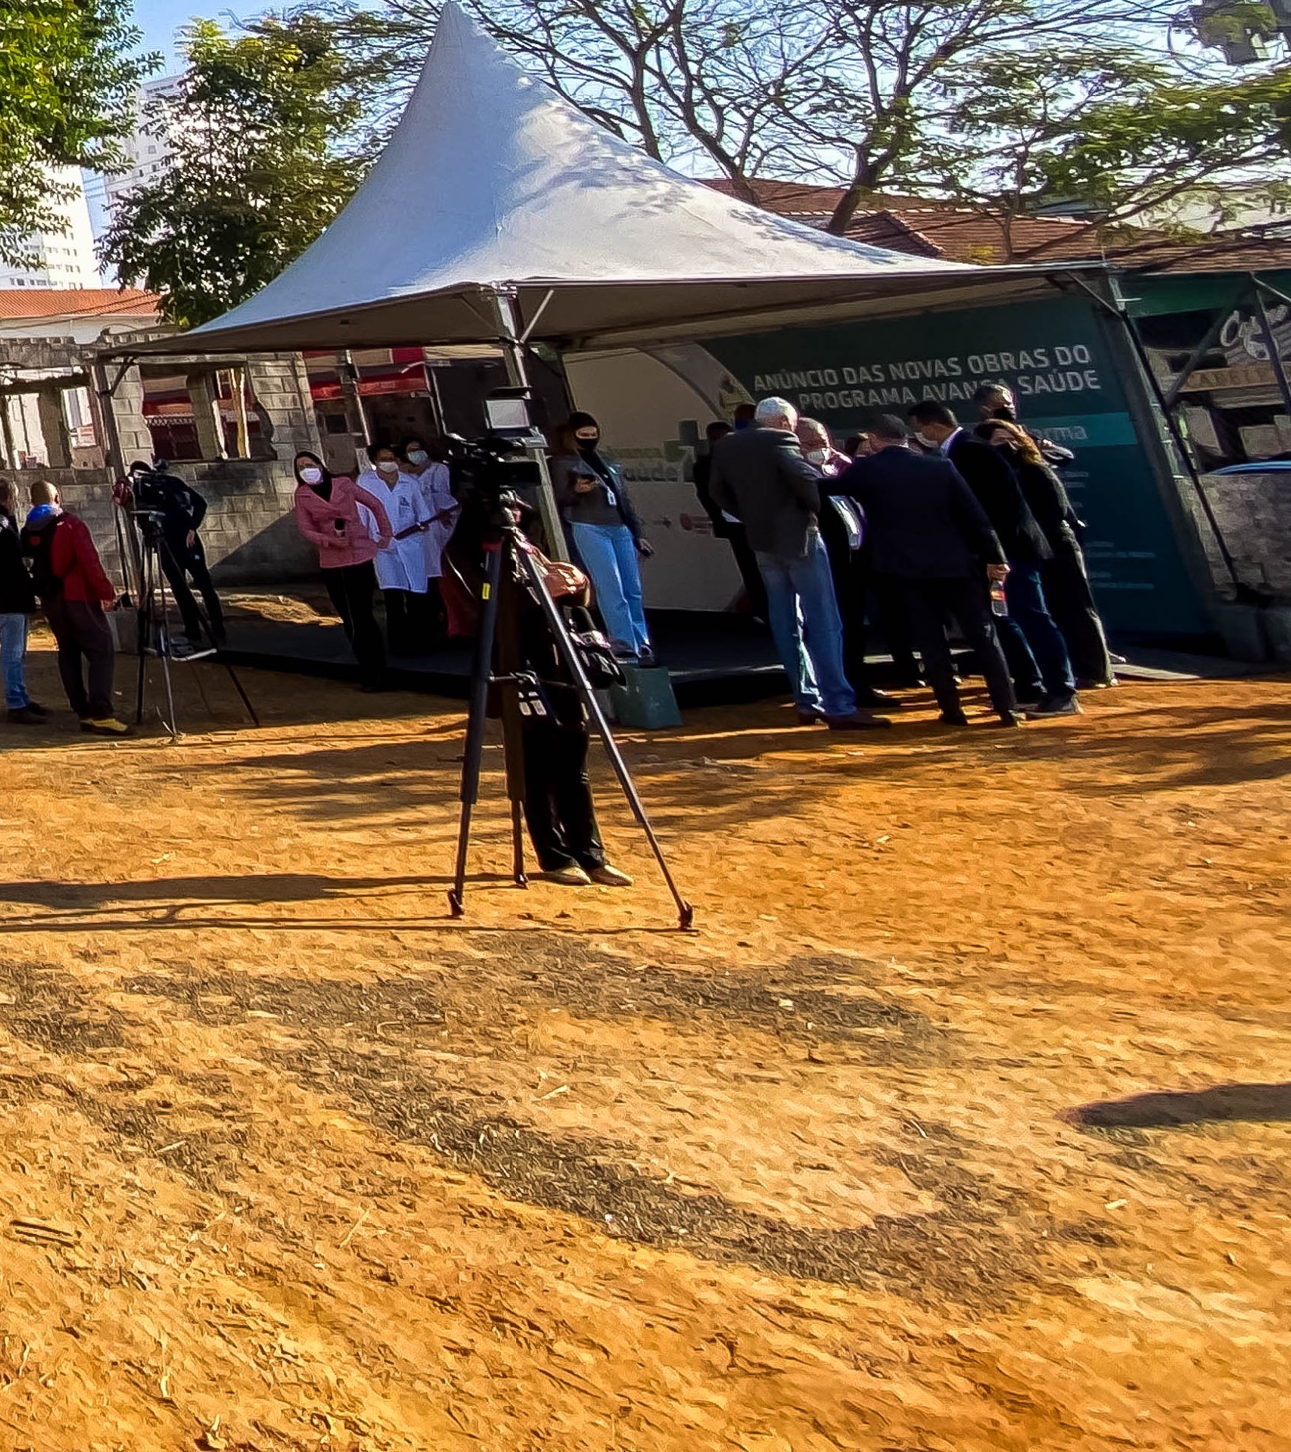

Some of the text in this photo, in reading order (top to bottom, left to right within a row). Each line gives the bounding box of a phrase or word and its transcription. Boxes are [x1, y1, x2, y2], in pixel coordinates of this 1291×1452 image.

[753, 344, 1091, 391] ANÚNCIO DAS NOVAS OBRAS DO
[798, 368, 1101, 411] PROGRAMA AVAN SAÚDE
